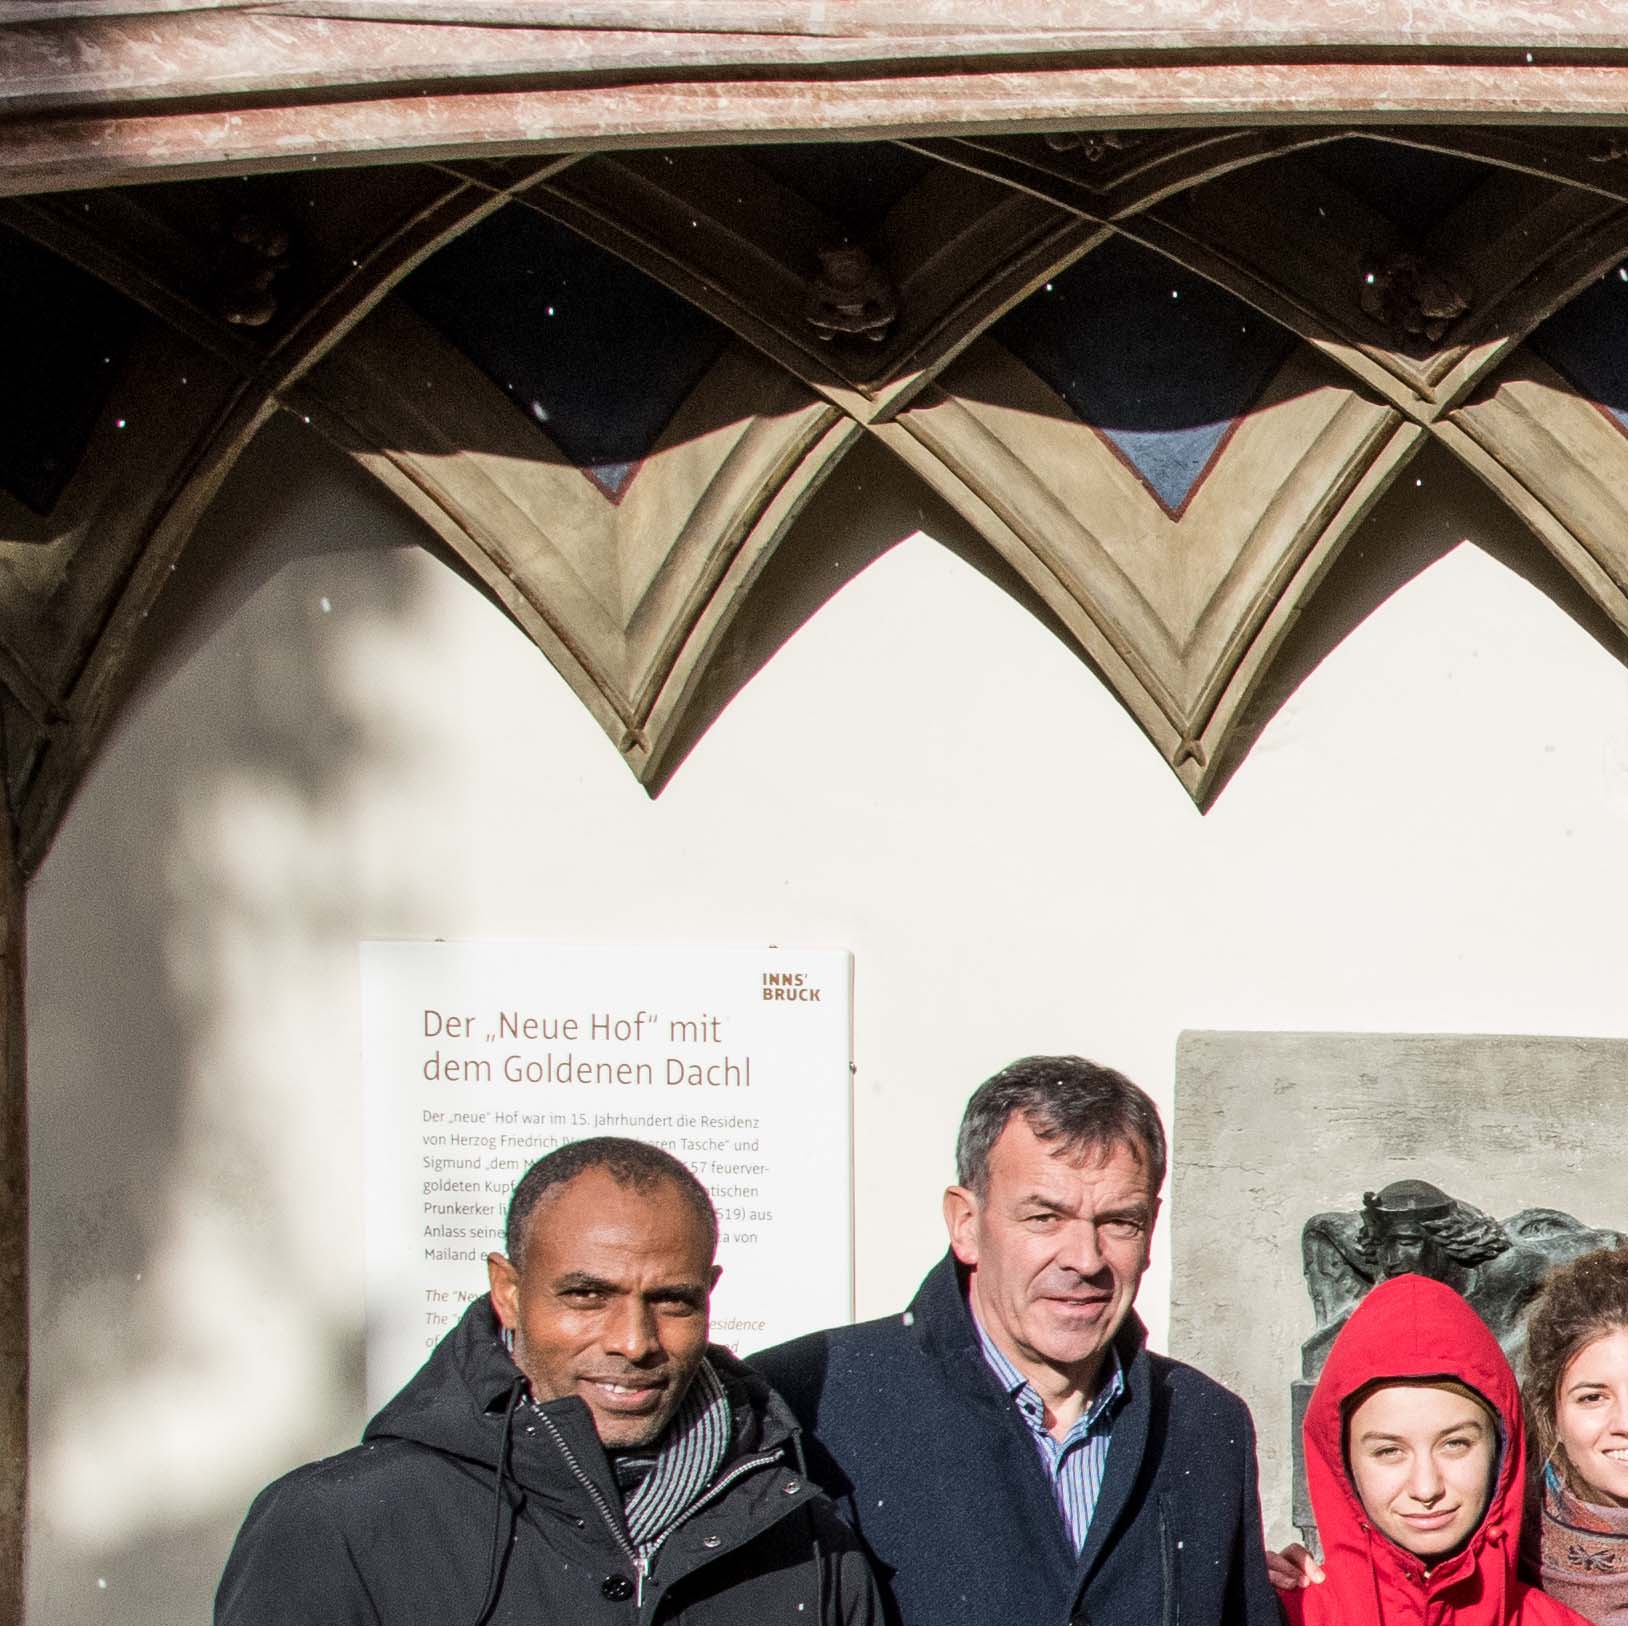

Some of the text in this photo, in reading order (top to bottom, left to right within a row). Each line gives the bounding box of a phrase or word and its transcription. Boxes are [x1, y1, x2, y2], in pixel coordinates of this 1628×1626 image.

[762, 988, 821, 1002] BRUCK
[423, 1009, 476, 1038] Der
[670, 1014, 723, 1043] mit
[423, 1051, 751, 1087] dem Goldenen Dachl
[422, 1109, 445, 1124] Der
[495, 1110, 519, 1125] Hof
[522, 1113, 546, 1125] war
[550, 1112, 567, 1126] im
[571, 1112, 591, 1127] 15.
[593, 1112, 673, 1129] Jahrhundert
[676, 1114, 697, 1129] die
[700, 1115, 760, 1130] Residenz
[422, 1134, 447, 1147] von
[450, 1133, 498, 1151] Herzog
[500, 1134, 559, 1149] Friedrich
[733, 1138, 760, 1152] und
[422, 1155, 482, 1173] Sigmund
[422, 1178, 481, 1195] goldeten
[423, 1202, 495, 1216] Prunkerker
[749, 1210, 774, 1222] aus
[423, 1225, 466, 1239] Anlass
[734, 1232, 759, 1245] von
[424, 1248, 477, 1262] Mailand
[425, 1289, 449, 1303] The
[425, 1312, 449, 1326] The
